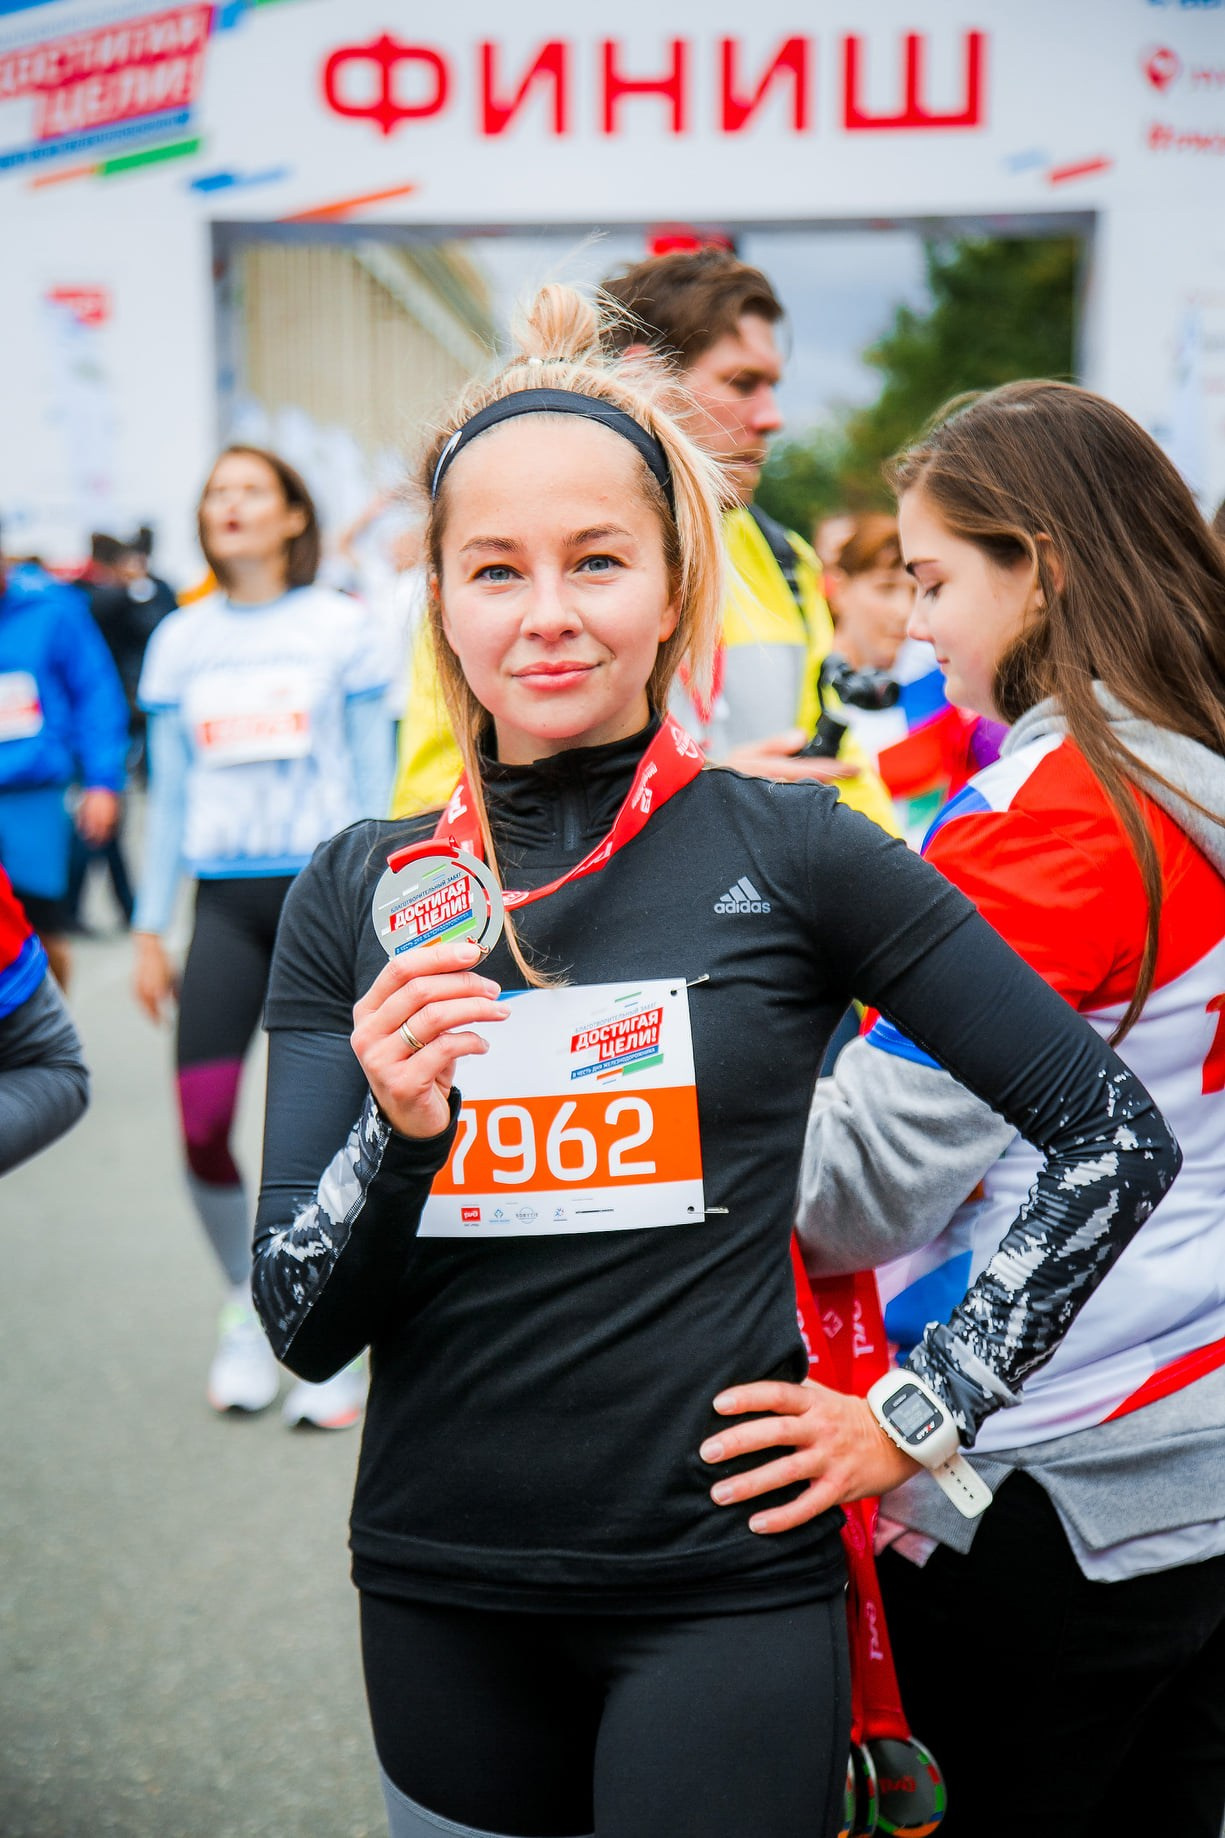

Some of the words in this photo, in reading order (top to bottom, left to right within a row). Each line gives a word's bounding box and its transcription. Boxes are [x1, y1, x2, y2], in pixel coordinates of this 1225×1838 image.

[323, 31, 983, 136] ФИНИШ
[394, 879, 466, 930] ДОСТИГАЯ
[418, 893, 468, 932] ЦЕЛИ!
[713, 900, 771, 914] adidas
[576, 1010, 659, 1051] ДОСТИГАЯ
[601, 1026, 657, 1059] ЦЕЛИ!
[452, 1096, 656, 1185] 7962
